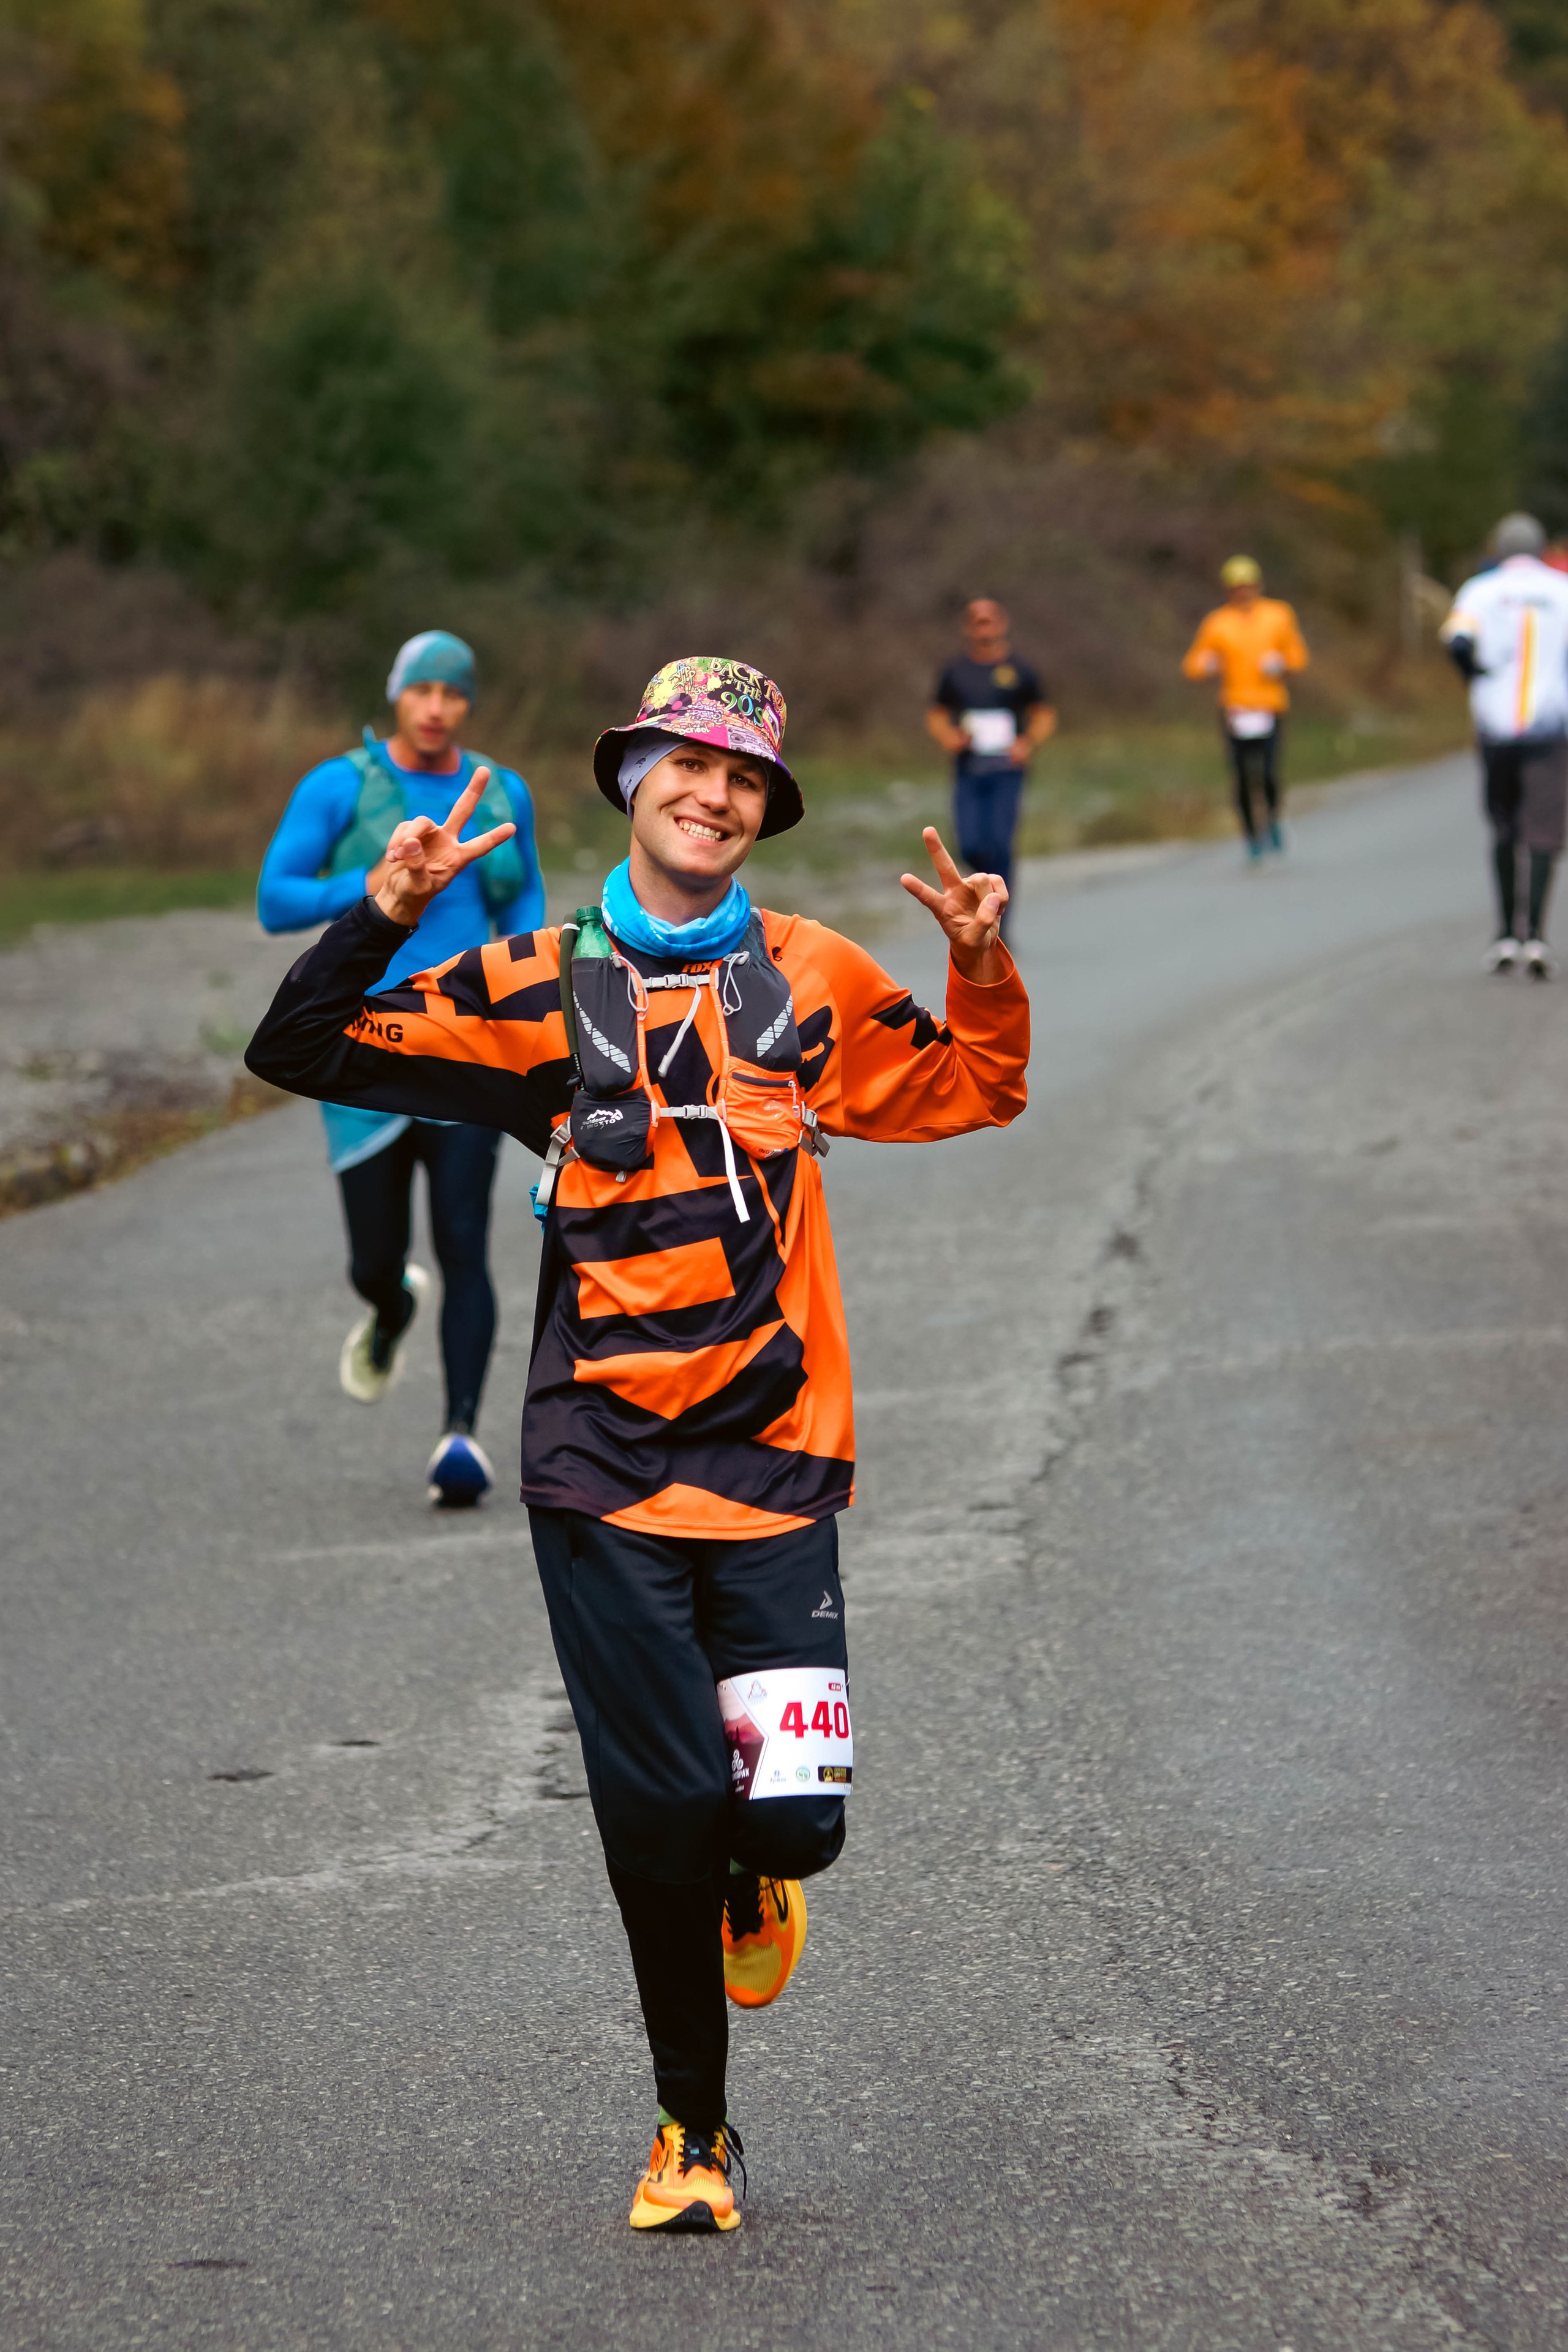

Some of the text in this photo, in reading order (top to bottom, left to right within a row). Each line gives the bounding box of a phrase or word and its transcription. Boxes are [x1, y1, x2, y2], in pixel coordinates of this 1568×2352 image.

[708, 657, 785, 710] BACK TO
[734, 679, 763, 703] THE
[682, 961, 712, 973] FOX
[811, 1610, 839, 1620] DEMIX
[779, 1700, 850, 1740] 440
